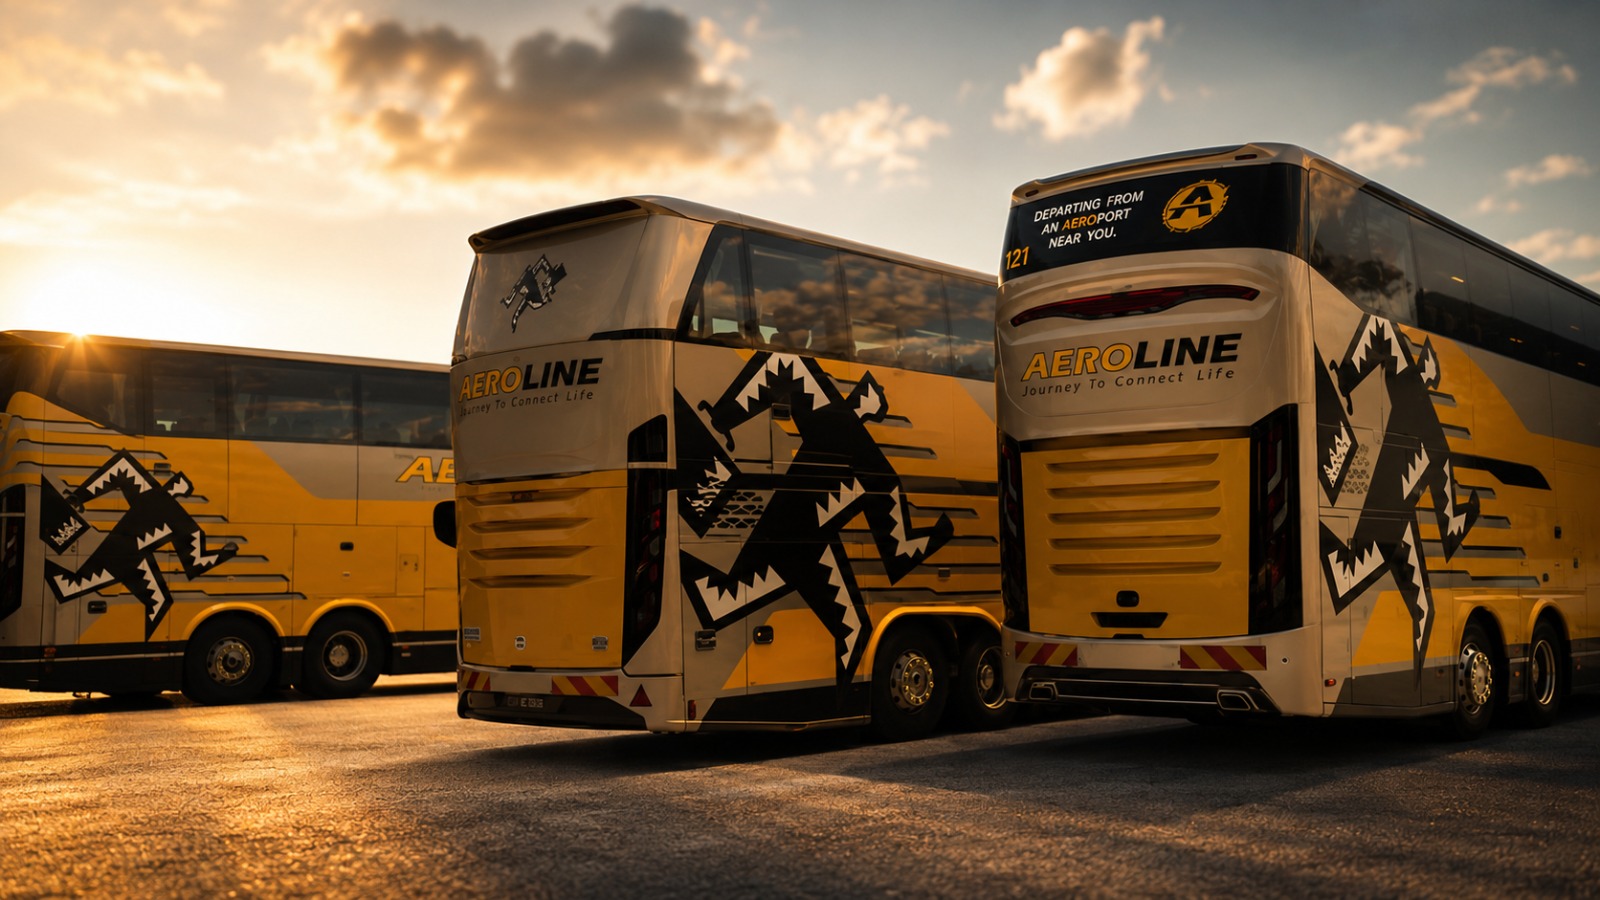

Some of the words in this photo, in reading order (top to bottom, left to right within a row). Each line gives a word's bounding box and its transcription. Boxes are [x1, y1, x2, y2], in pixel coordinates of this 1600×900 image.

[1034, 198, 1101, 222] DEPARTING
[1106, 190, 1144, 207] FROM
[1041, 223, 1059, 235] AN
[1062, 208, 1132, 231] AEROPORT
[1048, 232, 1081, 249] NEAR
[1087, 227, 1117, 242] YOU.
[1005, 246, 1030, 270] 121
[1020, 333, 1242, 382] AEROLINE
[458, 357, 603, 403] AEROLINE
[1022, 382, 1081, 397] Journey
[1089, 379, 1106, 390] To
[1115, 371, 1184, 387] Connect
[1197, 368, 1235, 381] Life
[495, 400, 506, 410] To
[511, 392, 559, 407] Connect
[566, 389, 594, 401] Life
